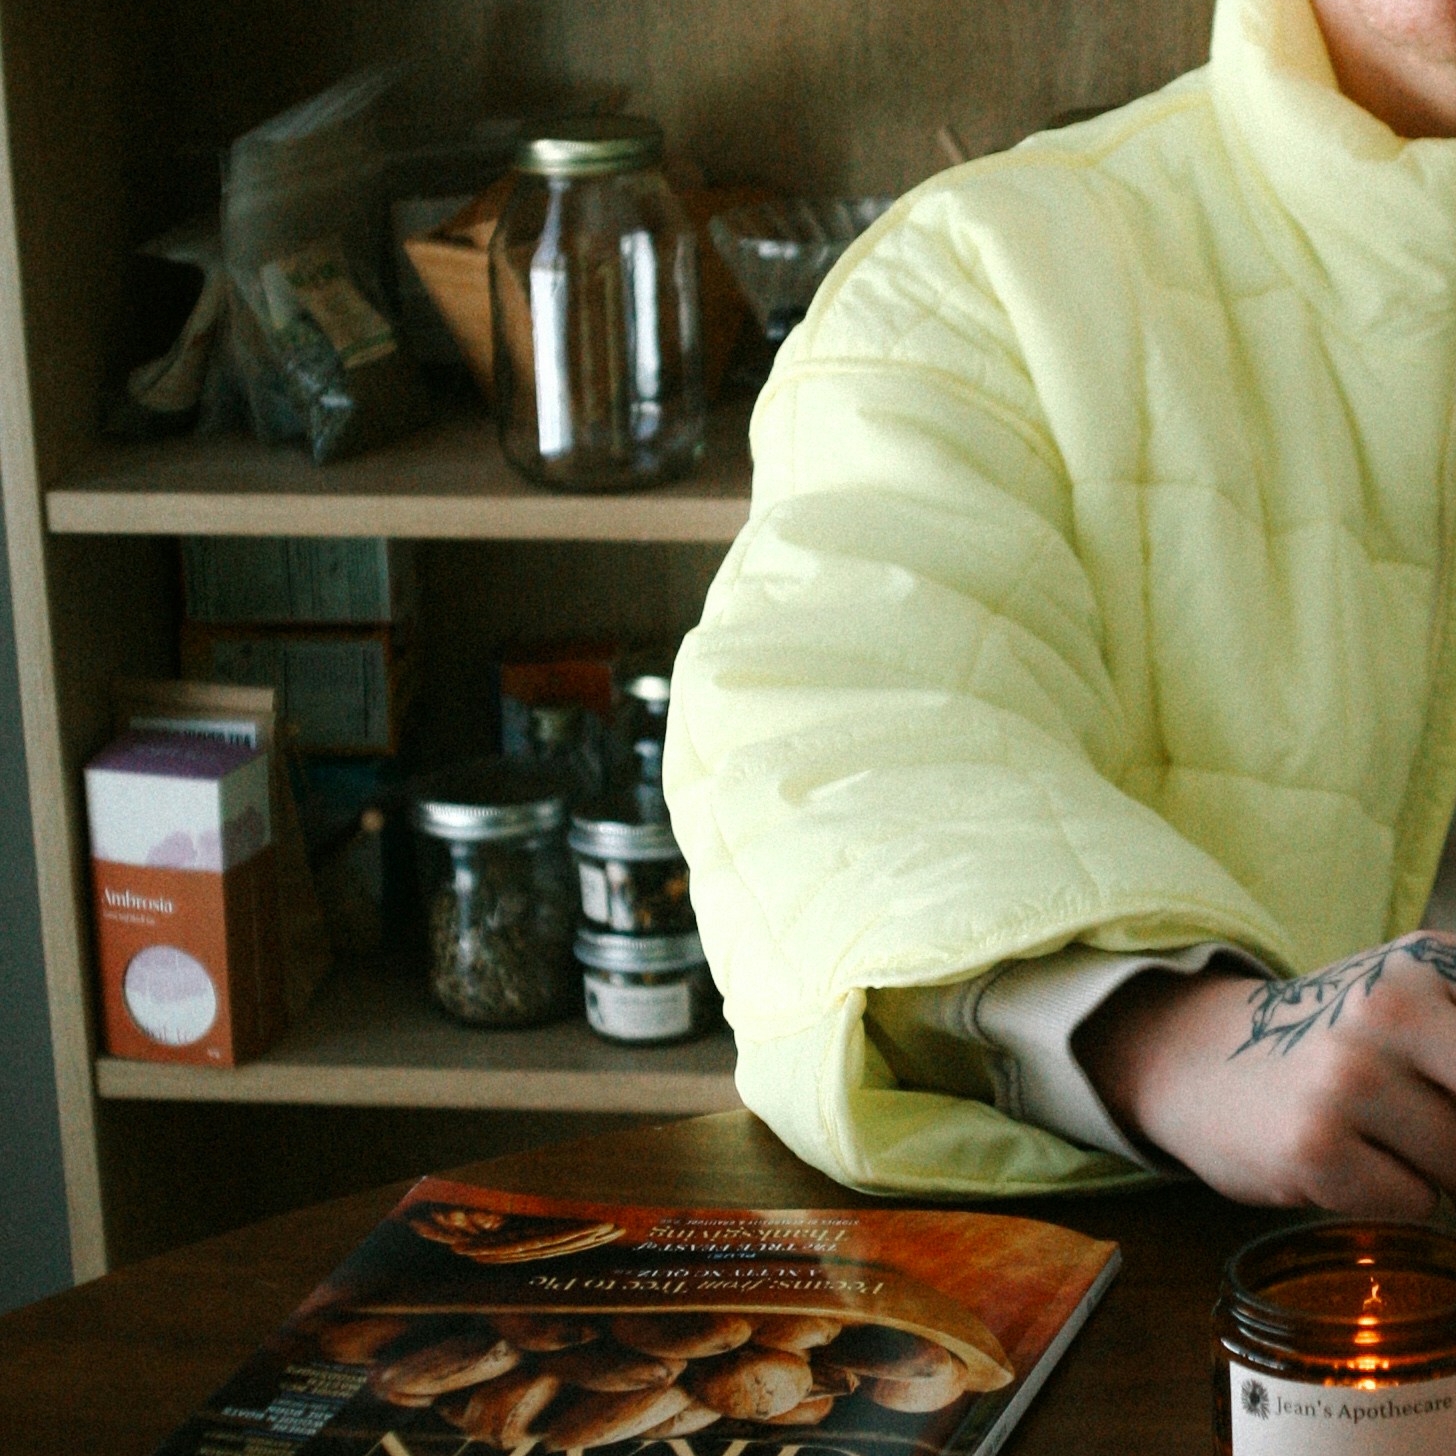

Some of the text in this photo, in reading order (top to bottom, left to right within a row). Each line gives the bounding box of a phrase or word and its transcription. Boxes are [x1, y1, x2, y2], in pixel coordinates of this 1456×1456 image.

[102, 887, 174, 913] Ambrosia
[647, 1225, 850, 1242] Thanksgiving
[529, 1275, 574, 1291] Pie
[583, 1278, 616, 1290] to
[624, 1279, 690, 1293] Tree
[768, 1278, 884, 1295] Pecans:
[1275, 1396, 1333, 1420] Jean's
